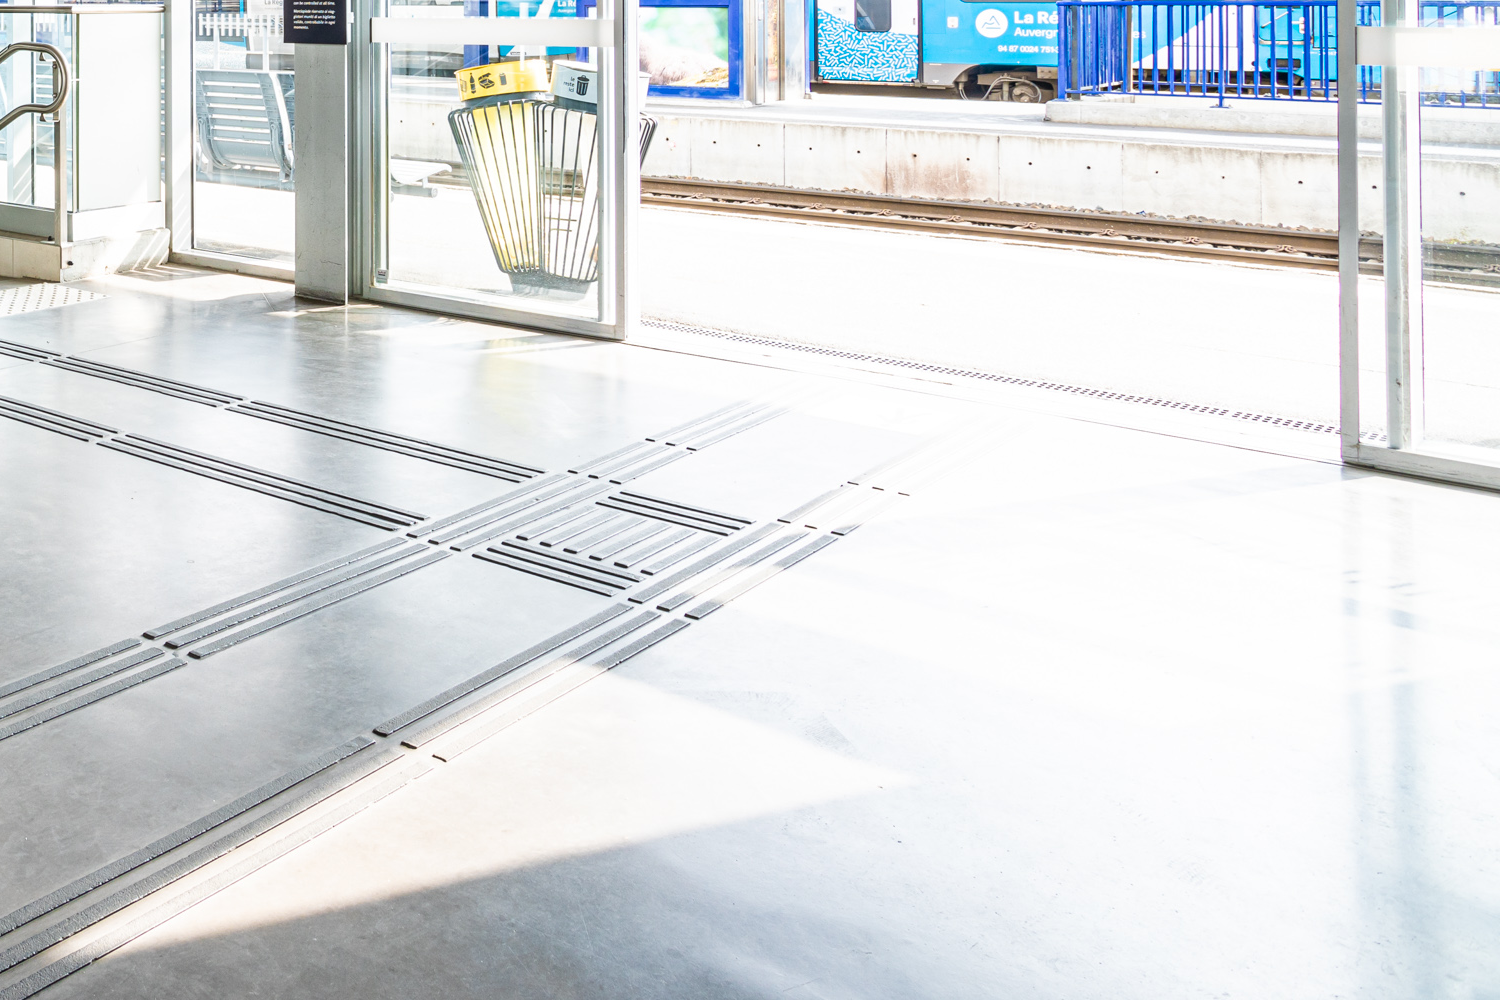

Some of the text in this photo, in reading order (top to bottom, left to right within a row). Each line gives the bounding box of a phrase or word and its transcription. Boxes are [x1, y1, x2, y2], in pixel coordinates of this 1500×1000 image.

[1014, 11, 1058, 24] La Ré
[1020, 45, 1039, 53] 0024
